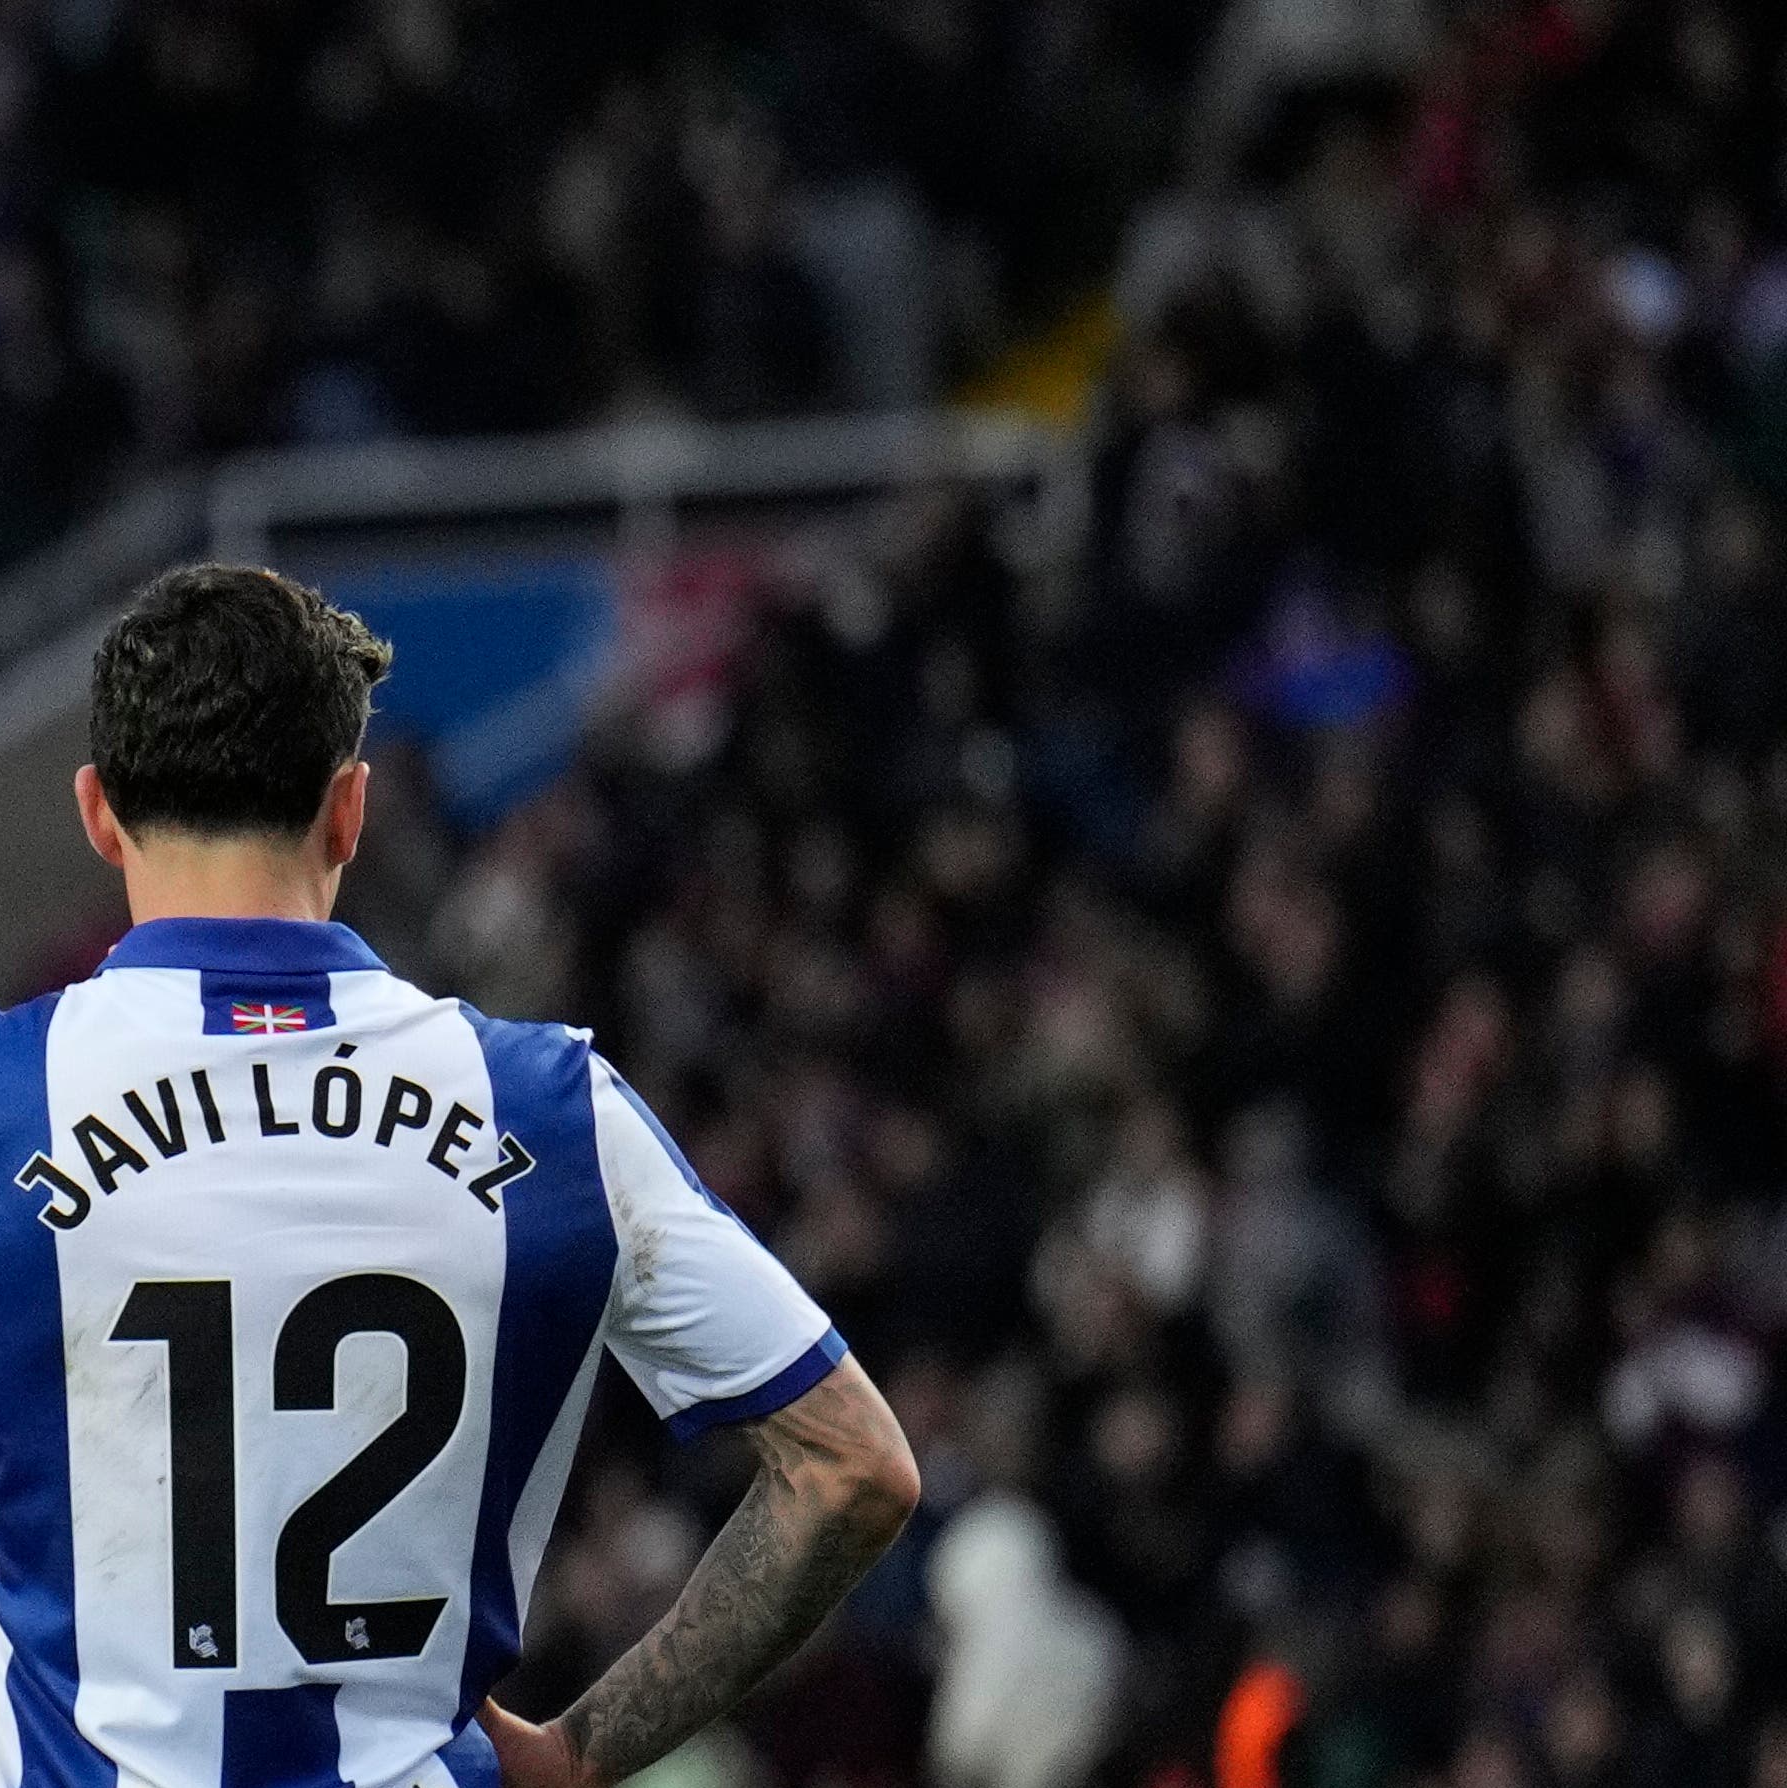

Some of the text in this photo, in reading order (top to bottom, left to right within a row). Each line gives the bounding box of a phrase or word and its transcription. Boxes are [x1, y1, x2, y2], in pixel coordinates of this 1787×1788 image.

[14, 1042, 537, 1231] JAVI LÓPEZ
[104, 1272, 467, 1670] 12
